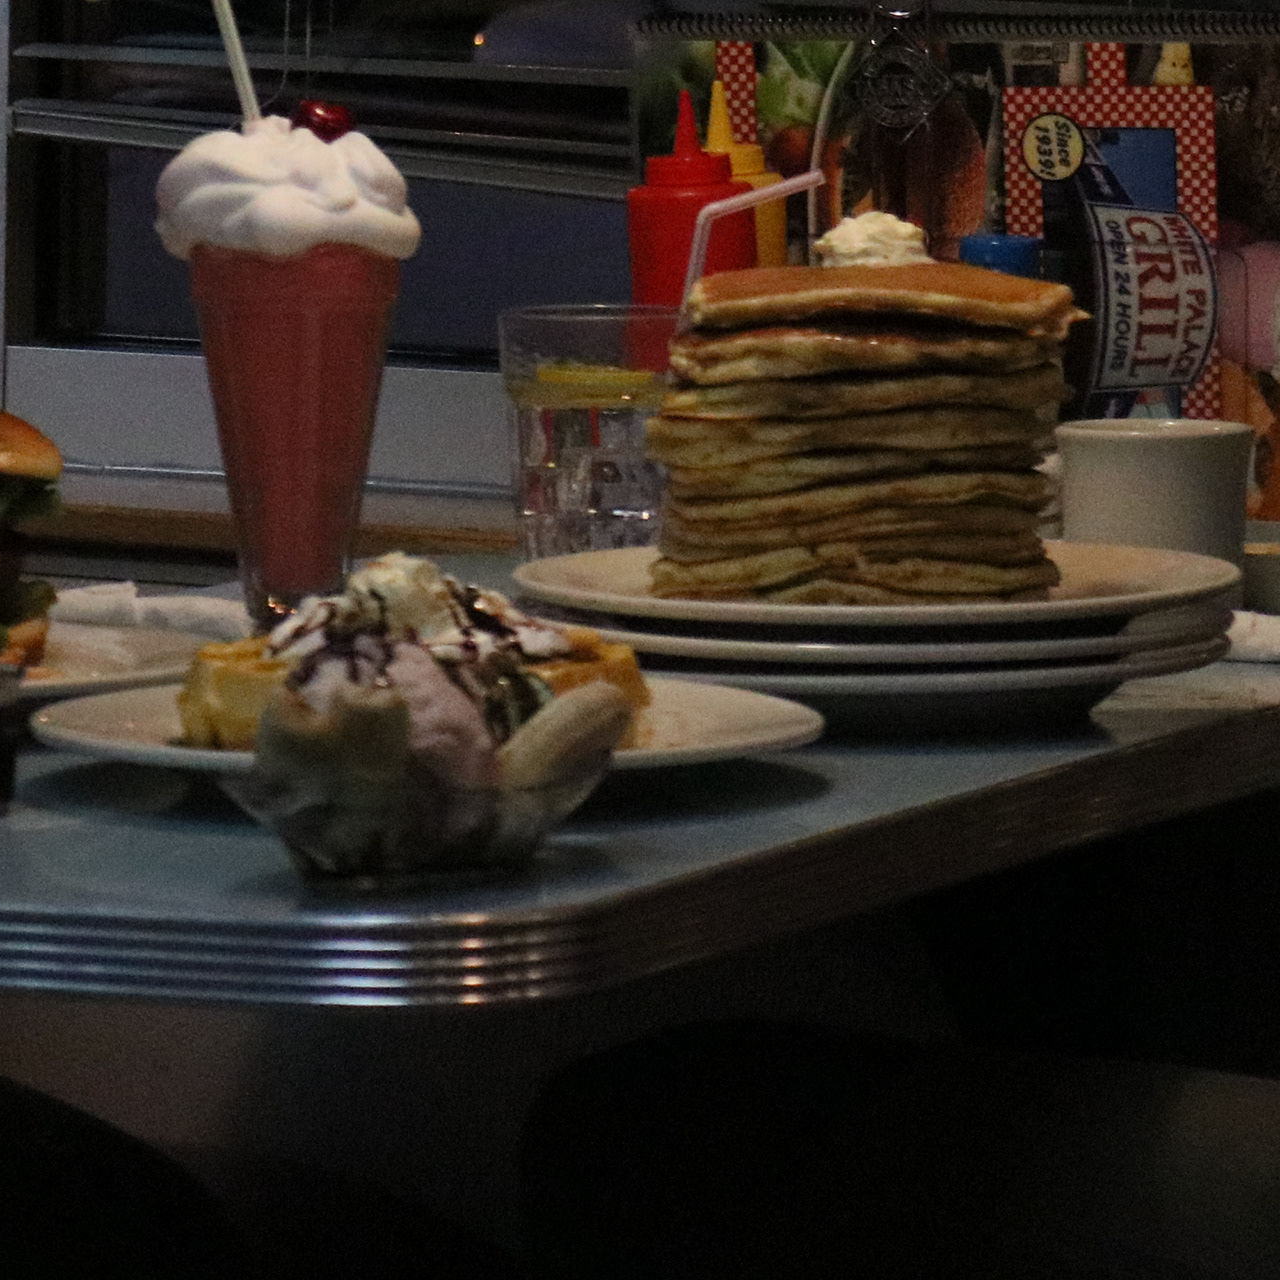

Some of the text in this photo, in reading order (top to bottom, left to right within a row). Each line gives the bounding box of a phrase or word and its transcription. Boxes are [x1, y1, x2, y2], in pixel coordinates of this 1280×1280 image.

[1034, 125, 1056, 177] 1939!
[1054, 120, 1071, 168] Since
[1105, 219, 1130, 266] OPEN
[1115, 272, 1132, 296] 24
[1125, 215, 1180, 379] GRILL
[1162, 216, 1207, 379] WHITE PALACE
[1108, 303, 1132, 372] HOURS
